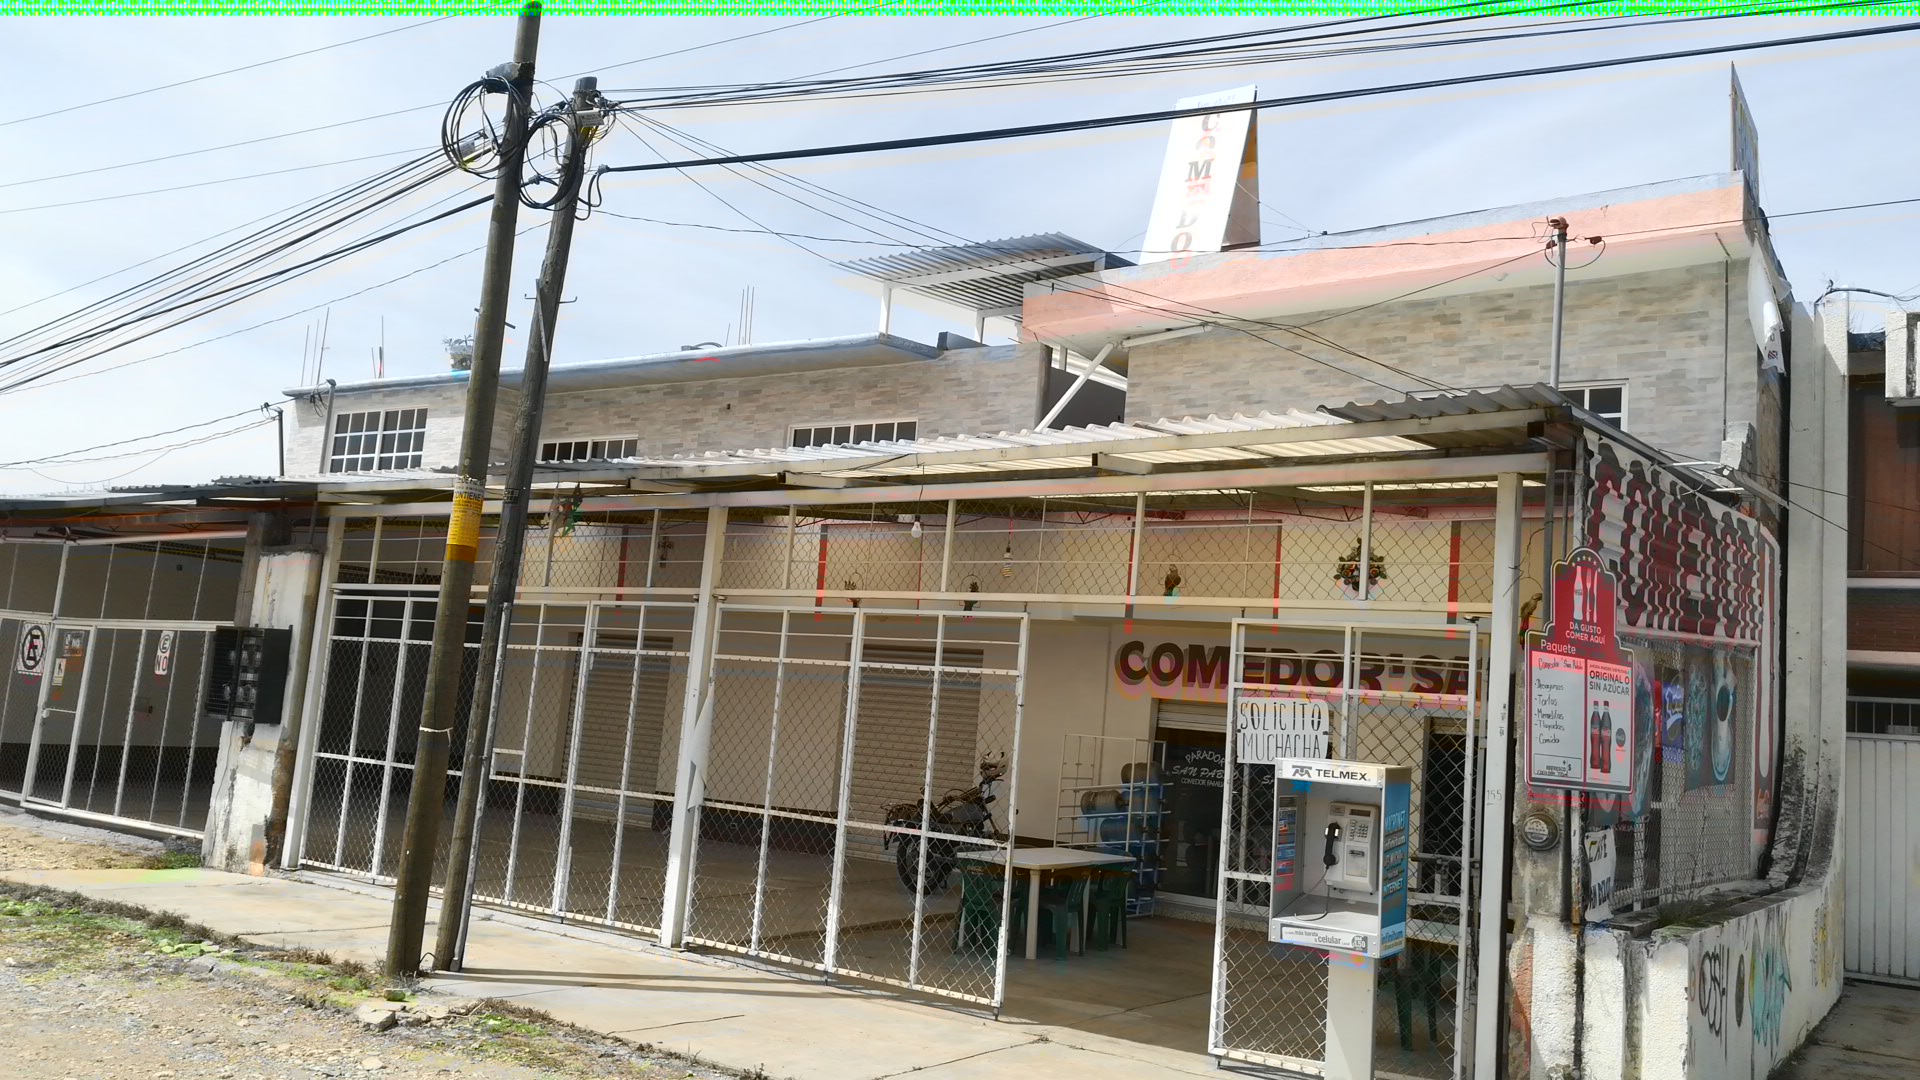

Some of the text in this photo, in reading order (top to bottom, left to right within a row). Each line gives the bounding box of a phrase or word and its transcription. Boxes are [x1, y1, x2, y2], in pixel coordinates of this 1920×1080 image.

[1569, 621, 1602, 635] DA GUSTO
[1565, 630, 1606, 645] COMER AQUÍ
[1540, 639, 1576, 654] Paquete
[156, 655, 169, 671] NO
[1589, 670, 1623, 685] ORIGINAL
[1624, 676, 1630, 686] O
[1589, 681, 1630, 696] SIN AZÚCAR
[1241, 732, 1322, 762] MUCHACHA
[1171, 765, 1238, 780] SAN PABO
[1315, 768, 1368, 781] TELMEX
[1318, 935, 1342, 945] celular
